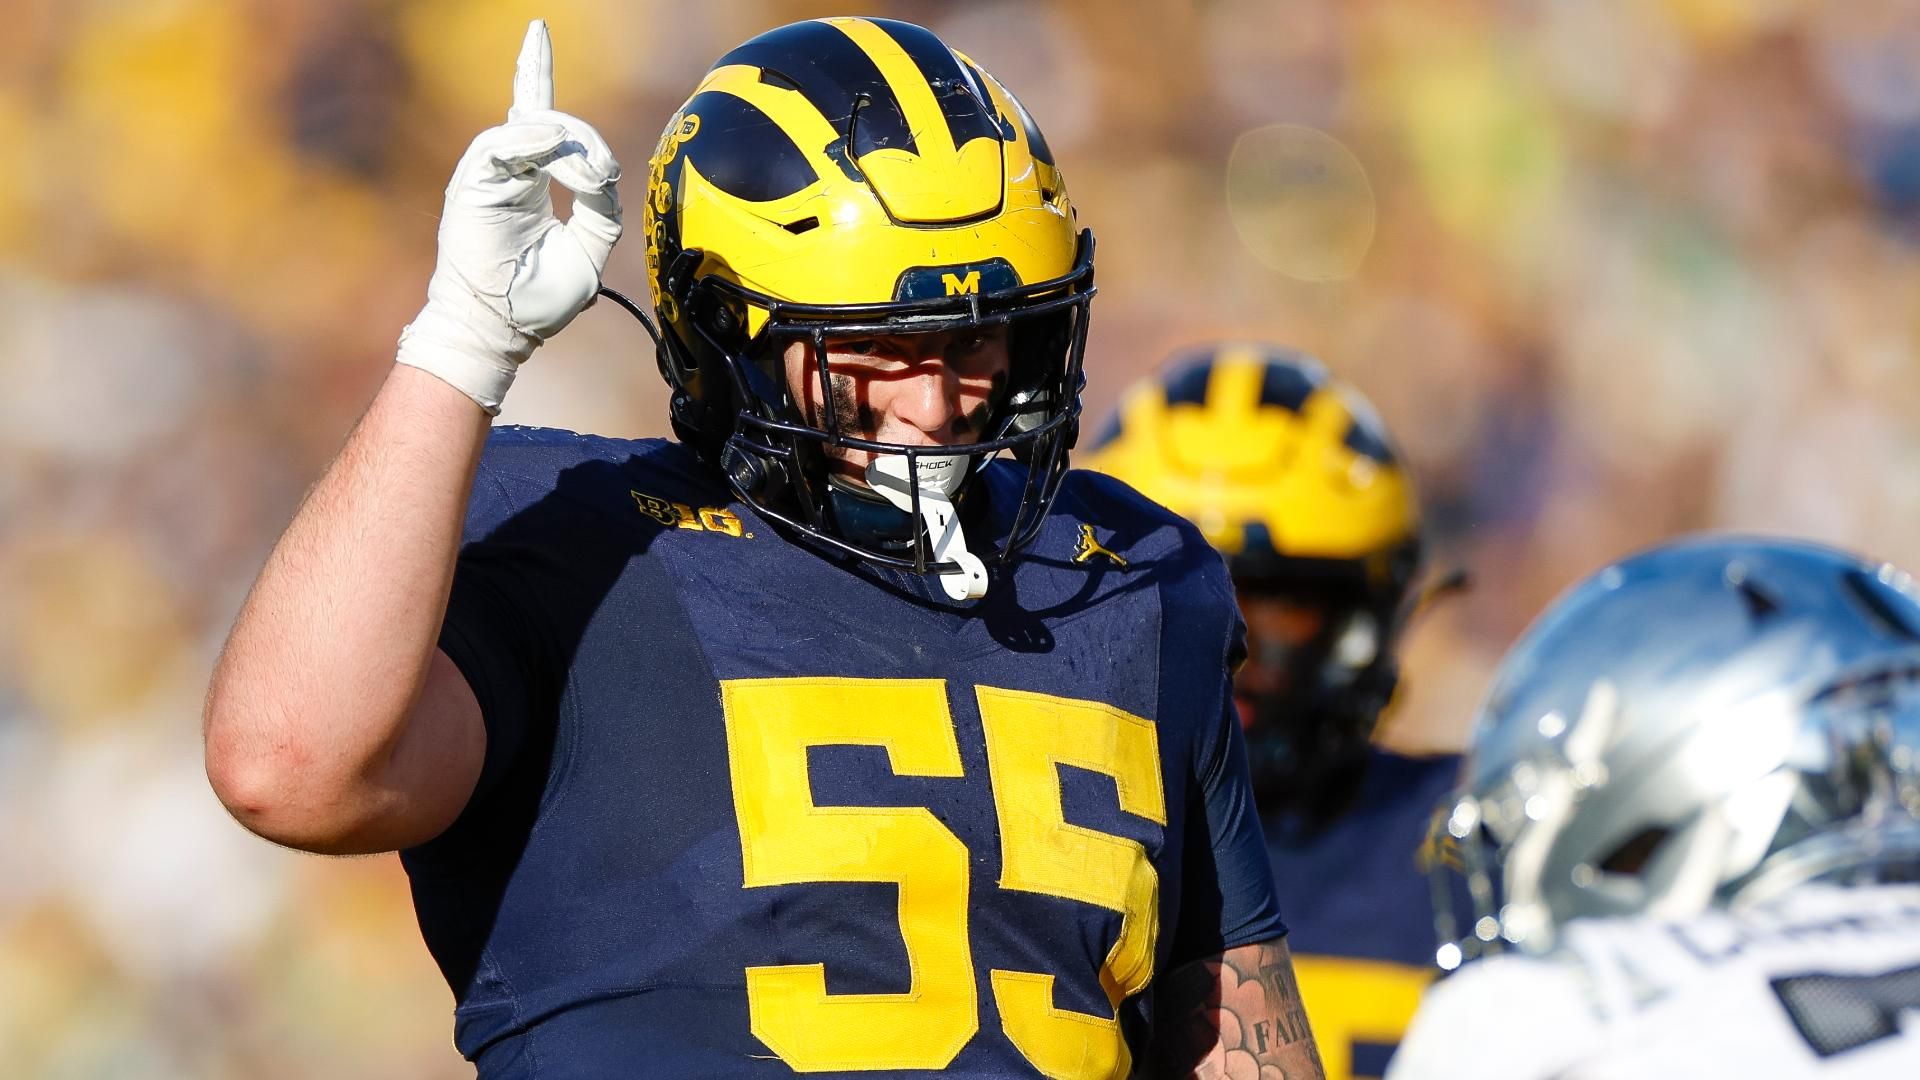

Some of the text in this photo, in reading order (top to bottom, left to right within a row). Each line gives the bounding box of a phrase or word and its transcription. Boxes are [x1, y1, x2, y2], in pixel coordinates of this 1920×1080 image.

[940, 270, 981, 297] M
[915, 458, 953, 470] SHOCK
[720, 676, 1168, 1080] 55
